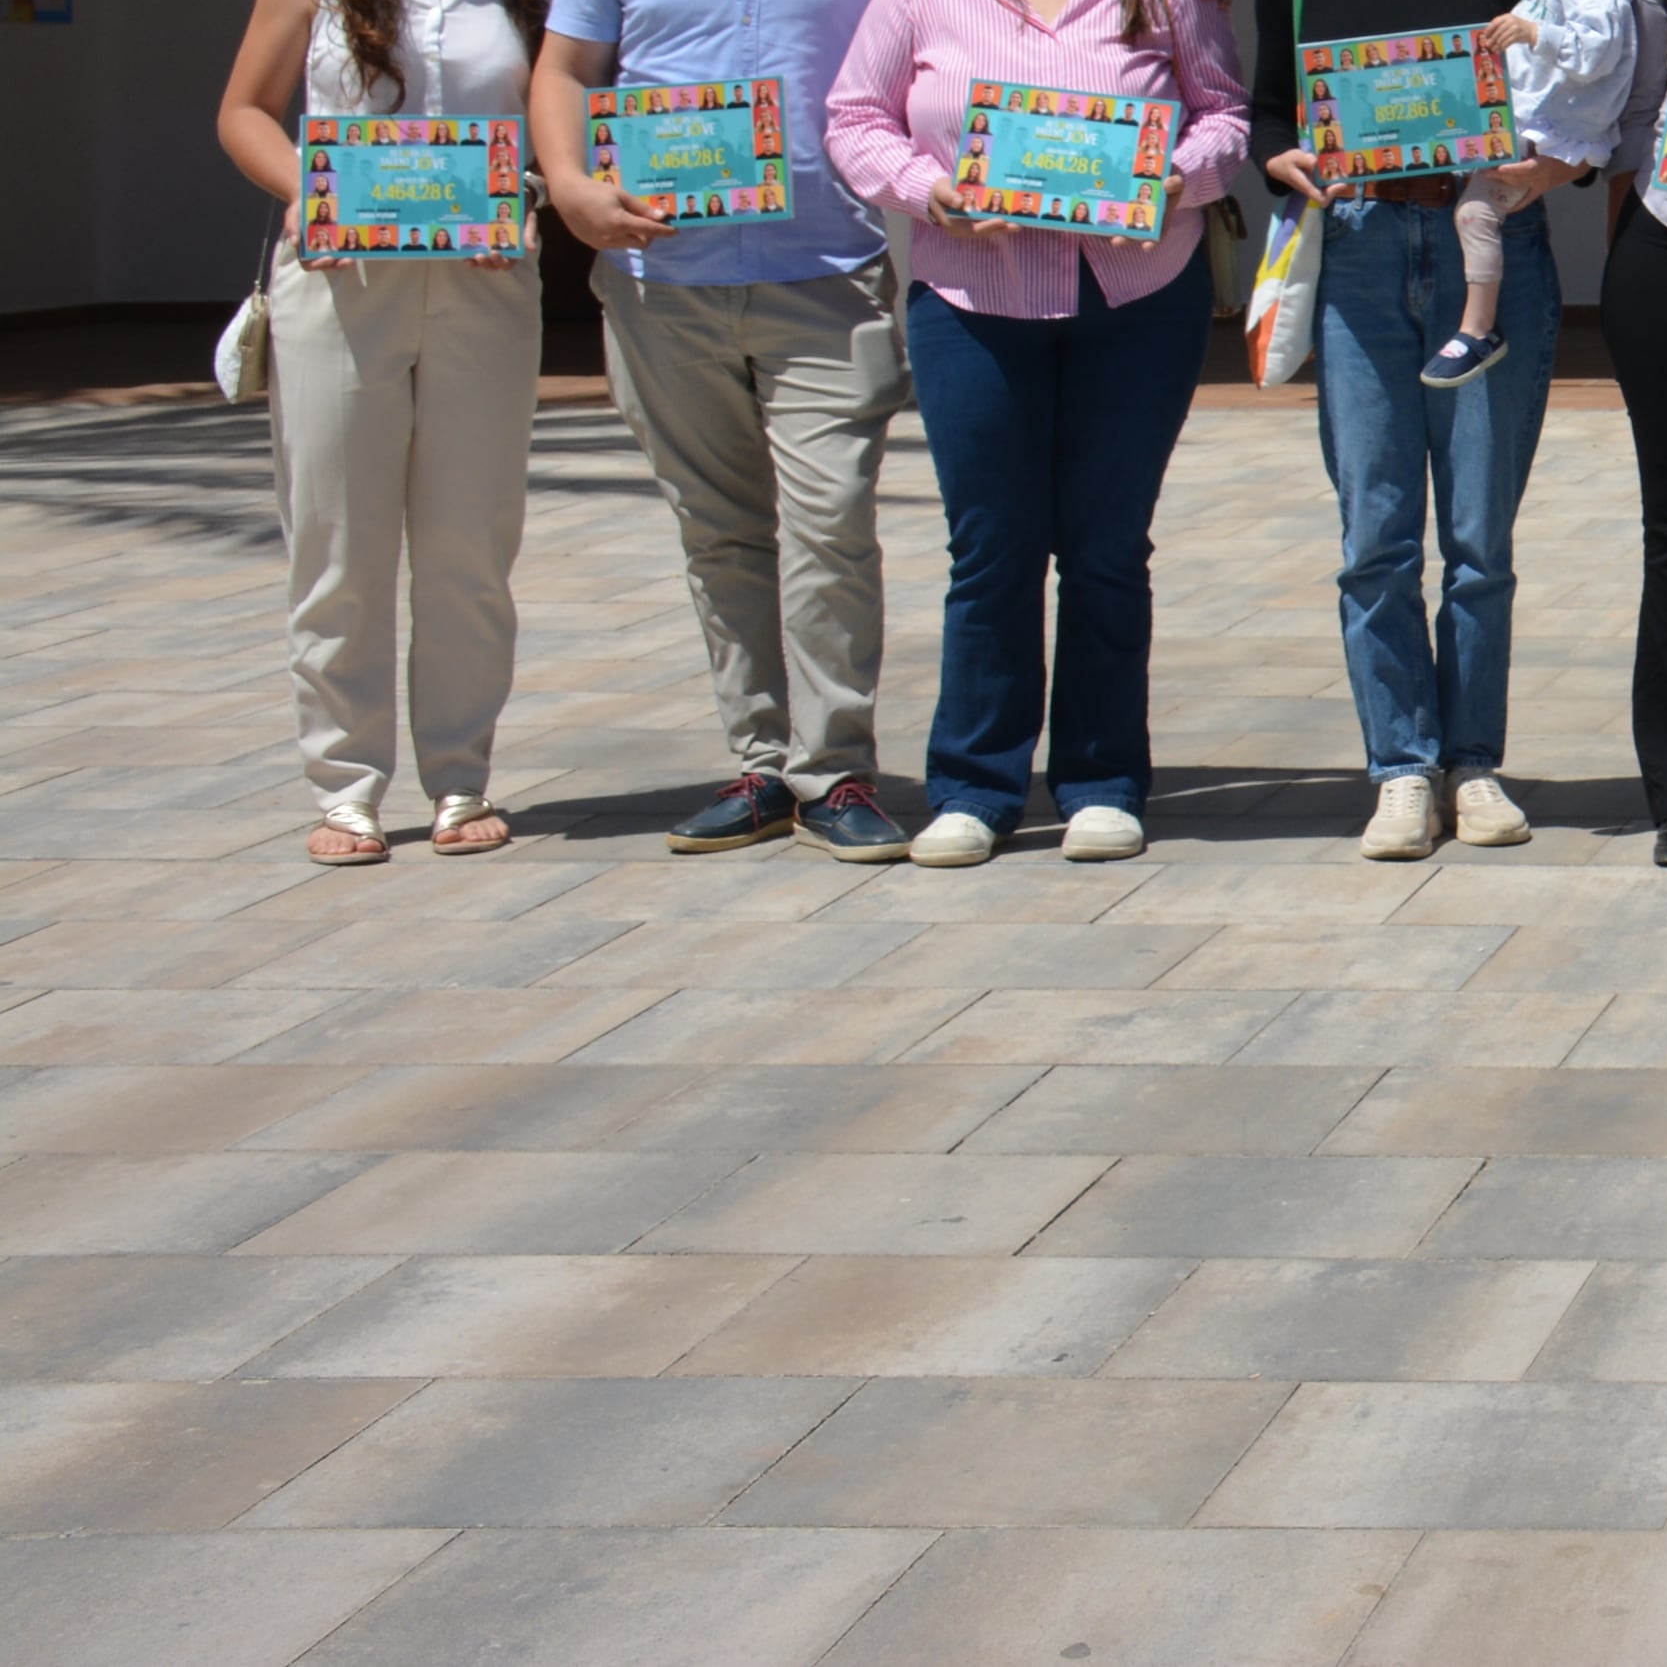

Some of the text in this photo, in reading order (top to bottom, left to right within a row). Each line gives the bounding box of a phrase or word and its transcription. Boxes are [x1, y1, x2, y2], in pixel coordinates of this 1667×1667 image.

[1402, 72, 1438, 89] JOVE
[683, 122, 716, 138] JOVE
[1063, 129, 1100, 146] JOVE
[411, 157, 447, 170] JOVE
